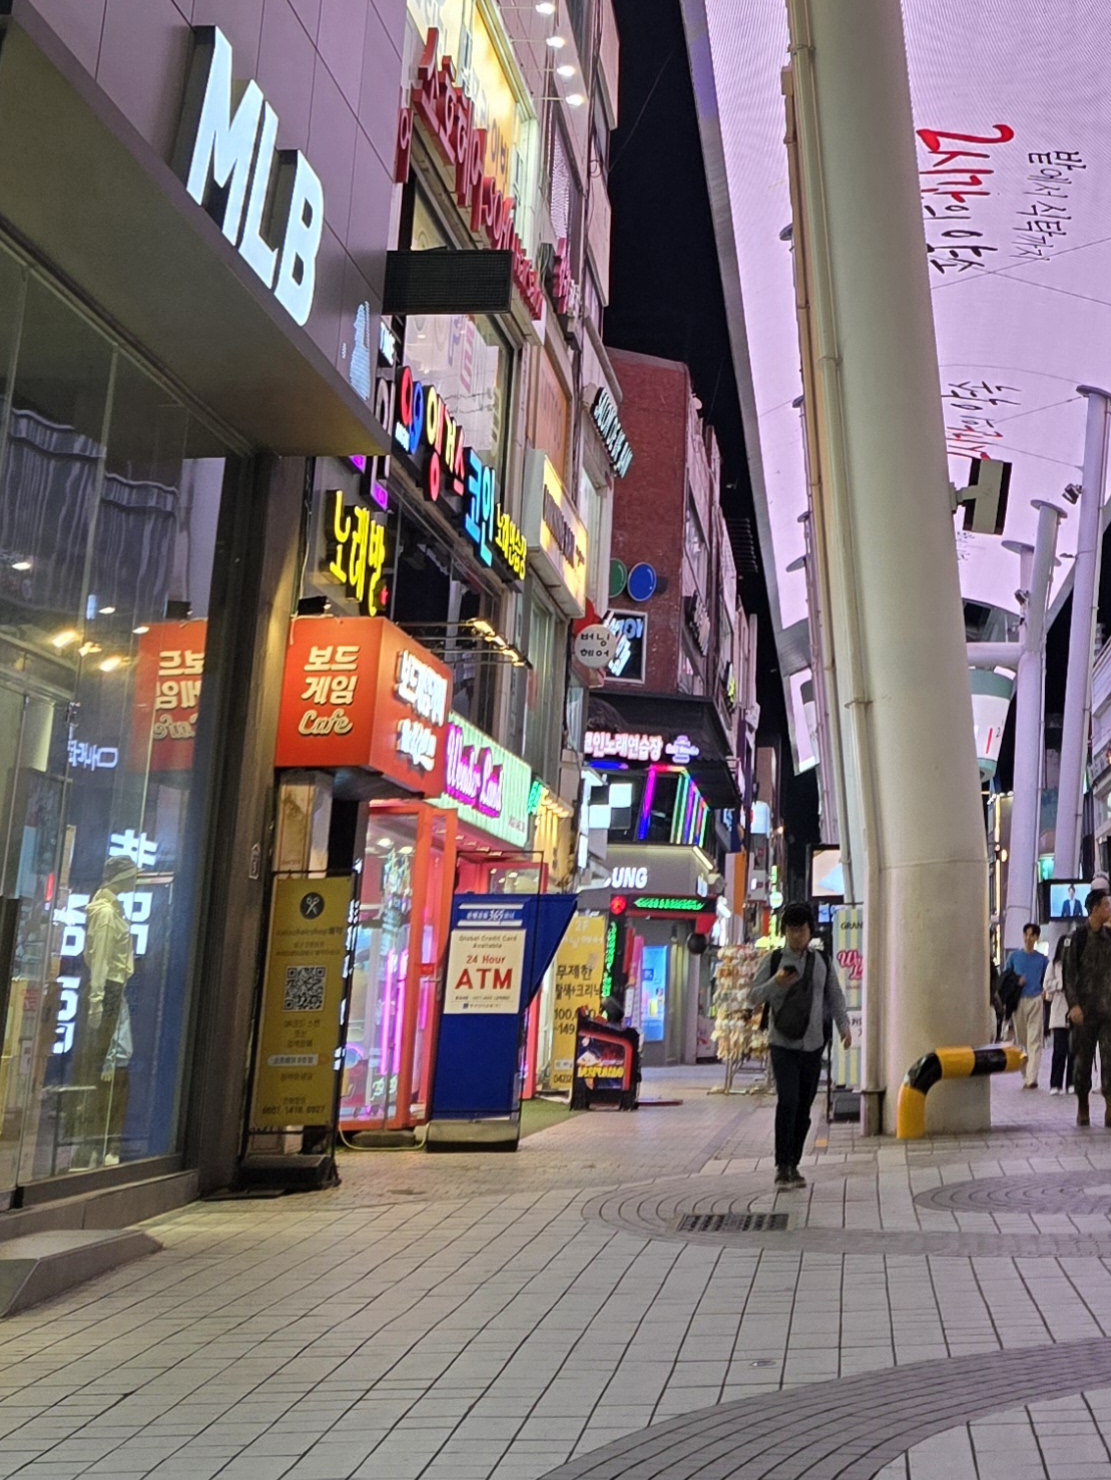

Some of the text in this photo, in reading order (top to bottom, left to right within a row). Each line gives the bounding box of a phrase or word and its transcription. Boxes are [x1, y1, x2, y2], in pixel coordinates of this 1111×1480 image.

[186, 25, 325, 327] MLB
[464, 448, 497, 568] 코인
[303, 644, 360, 672] 보드
[579, 648, 610, 657] 헤어
[301, 675, 357, 705] 게임
[298, 707, 353, 736] Cafe
[466, 955, 506, 965] 24 Hour
[455, 968, 513, 990] ATM
